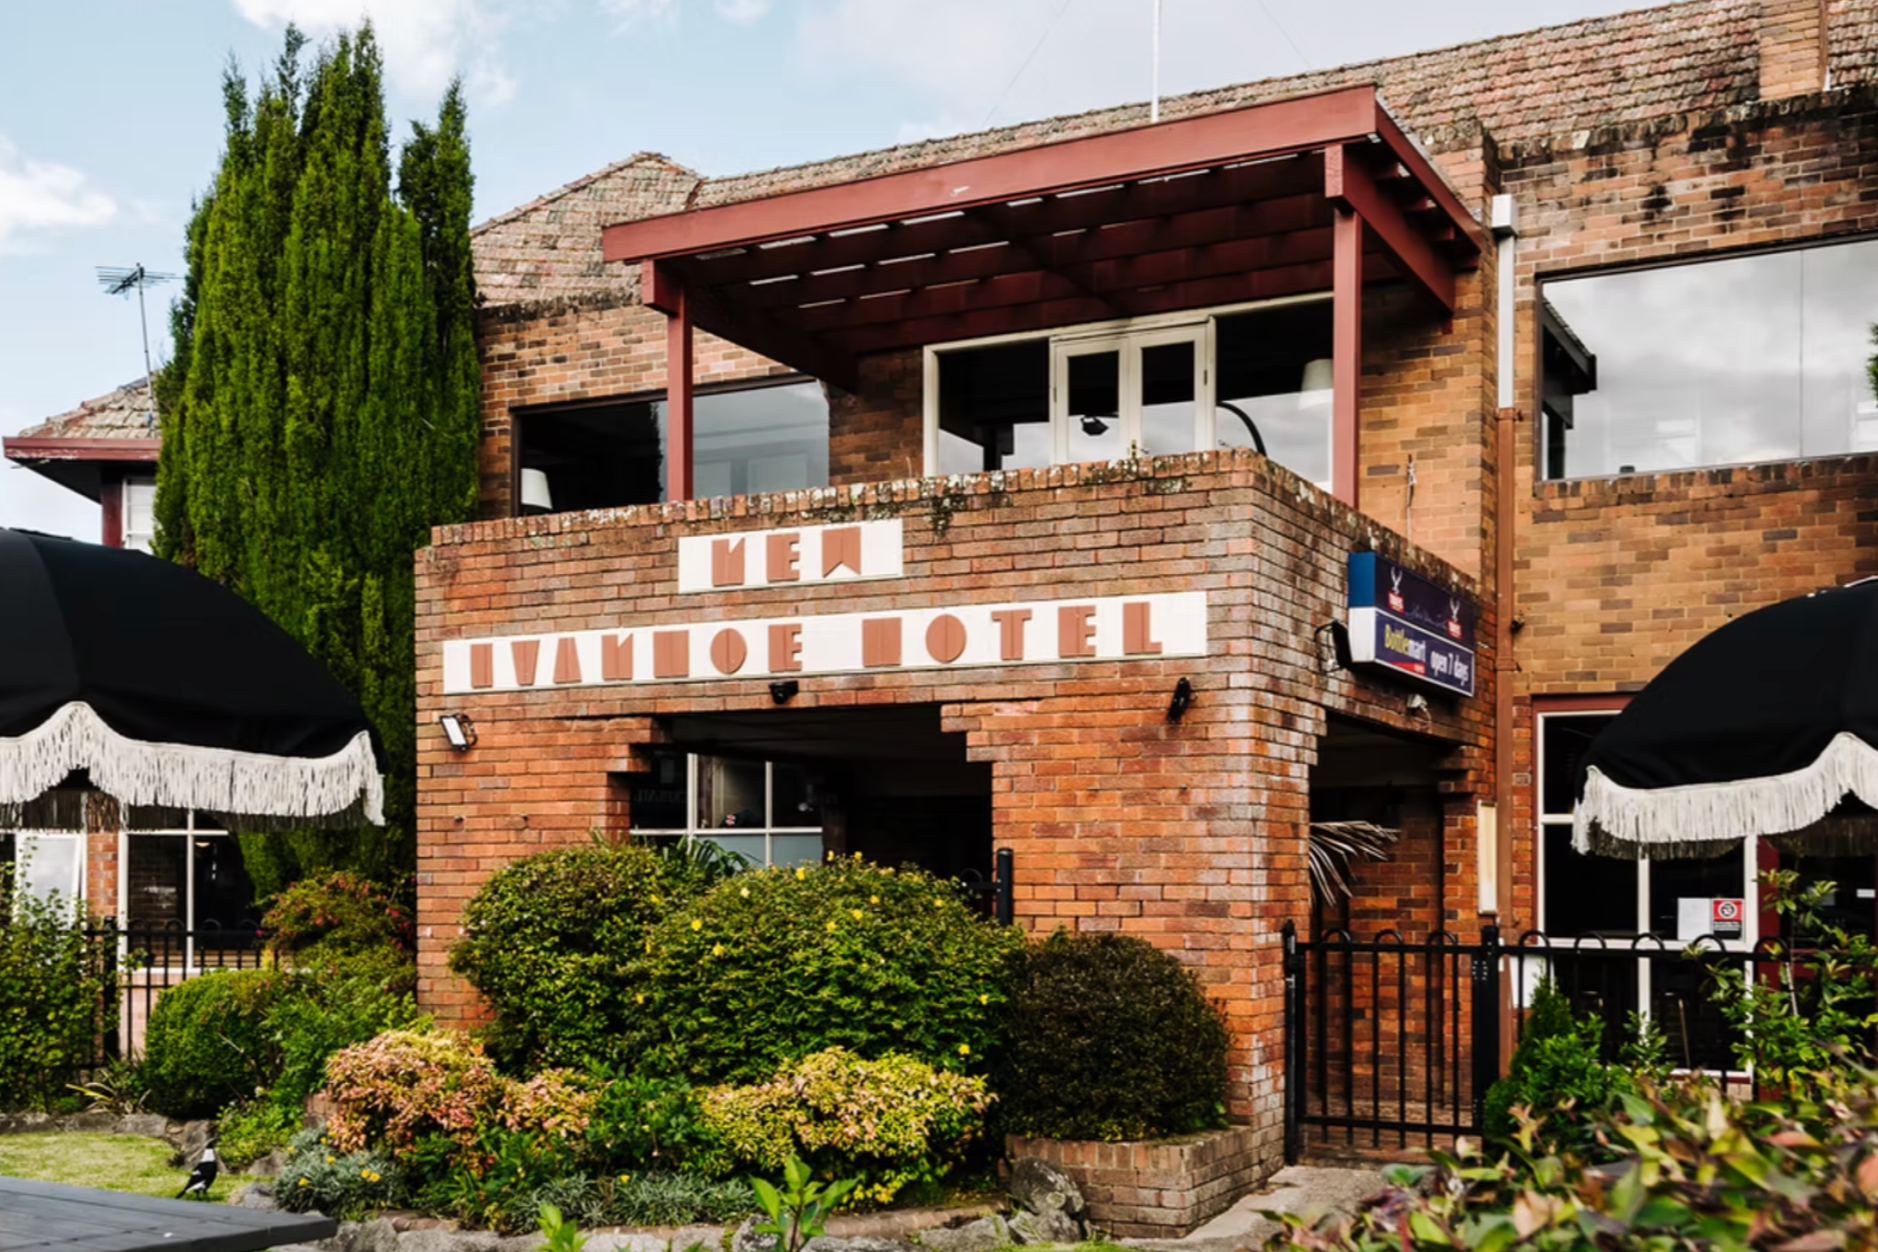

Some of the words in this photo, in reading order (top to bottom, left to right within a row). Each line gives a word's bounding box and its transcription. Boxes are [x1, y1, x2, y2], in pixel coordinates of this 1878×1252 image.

[711, 527, 861, 587] NEW
[470, 623, 802, 688] IVANHOE
[862, 602, 1162, 667] HOTEL
